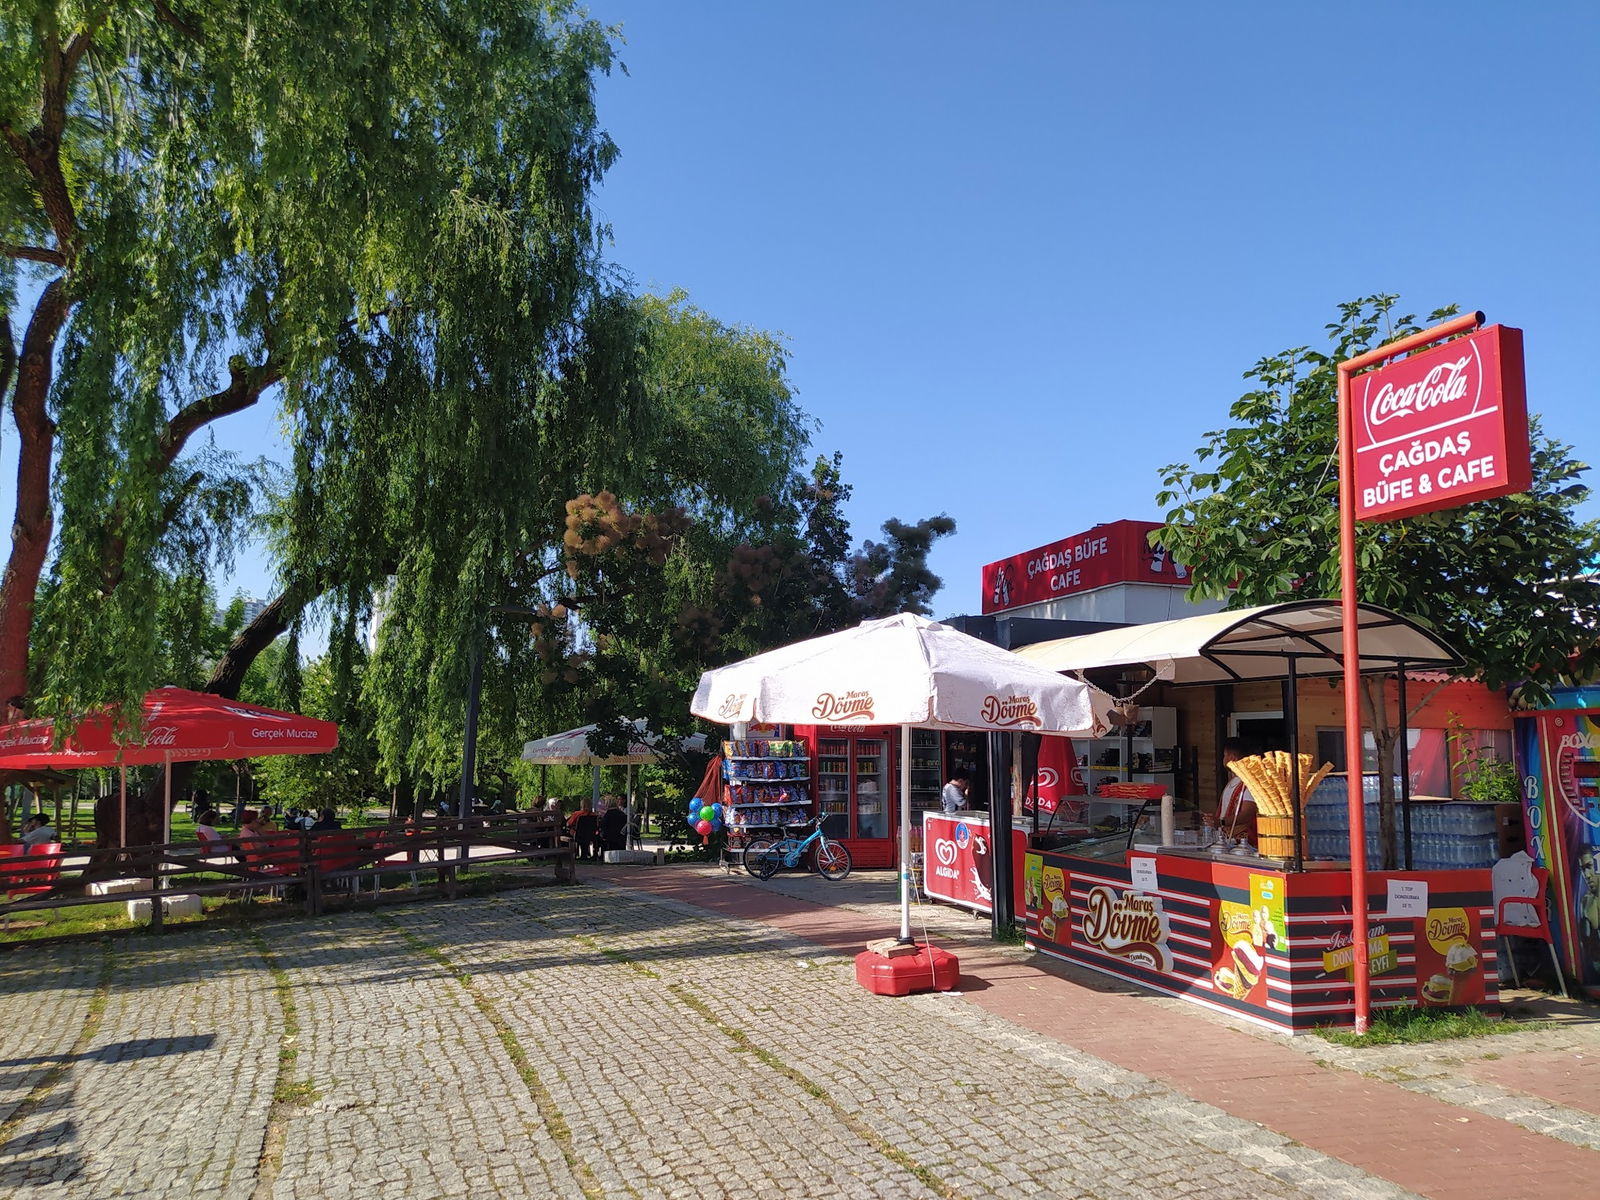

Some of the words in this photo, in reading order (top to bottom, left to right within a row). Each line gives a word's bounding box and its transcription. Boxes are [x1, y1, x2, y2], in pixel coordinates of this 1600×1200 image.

[1370, 354, 1472, 426] Coca-Cola
[1379, 431, 1472, 477] ÇAĞDAŞ
[1363, 478, 1414, 508] BÜFE
[1418, 473, 1432, 494] &
[1437, 456, 1495, 489] CAFE
[1027, 548, 1072, 579] ÇAĞDAŞ
[1074, 537, 1108, 562] BÜFE
[1050, 568, 1081, 591] CAFE
[811, 692, 874, 719] Dövme
[980, 695, 1038, 723] Dövme
[251, 727, 284, 740] Gerçek
[286, 728, 318, 739] Mucize
[1524, 775, 1547, 868] BOX
[935, 865, 957, 879] ALGIDA
[1084, 889, 1161, 943] Dövme
[1123, 894, 1154, 916] Maraş
